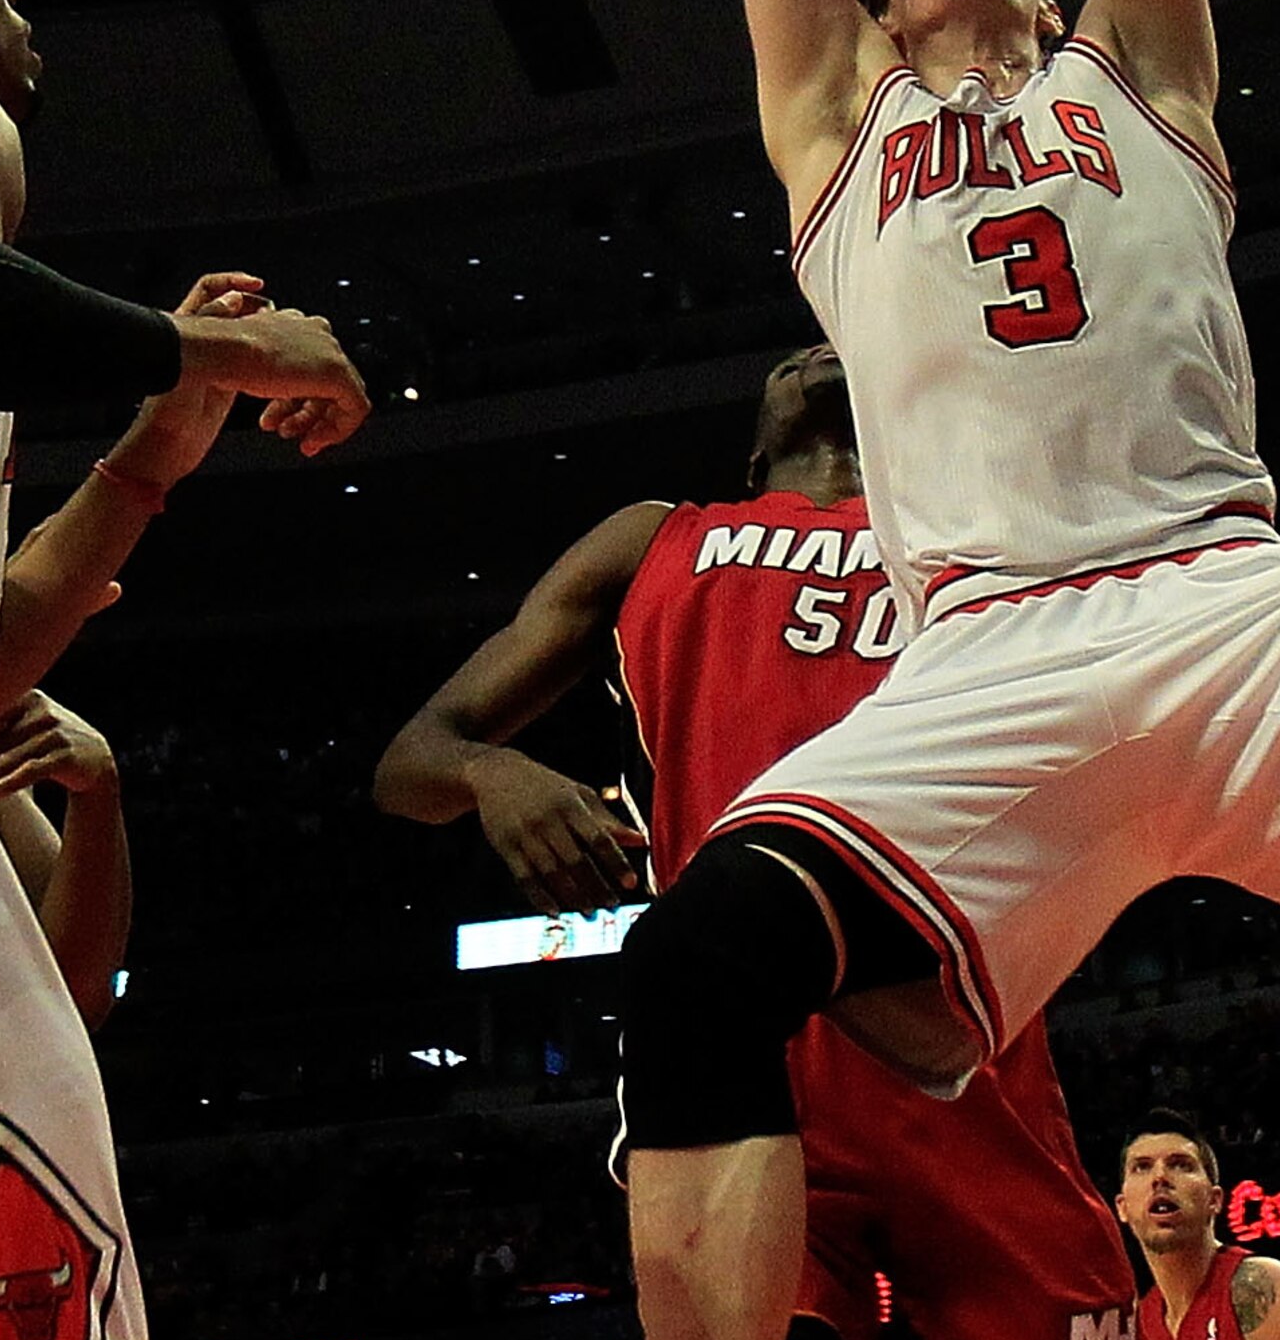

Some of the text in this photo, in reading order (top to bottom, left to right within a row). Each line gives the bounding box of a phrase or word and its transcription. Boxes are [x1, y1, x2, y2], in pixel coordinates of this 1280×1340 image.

[877, 100, 1122, 242] BULLS
[966, 205, 1092, 350] 3
[783, 584, 908, 659] 50
